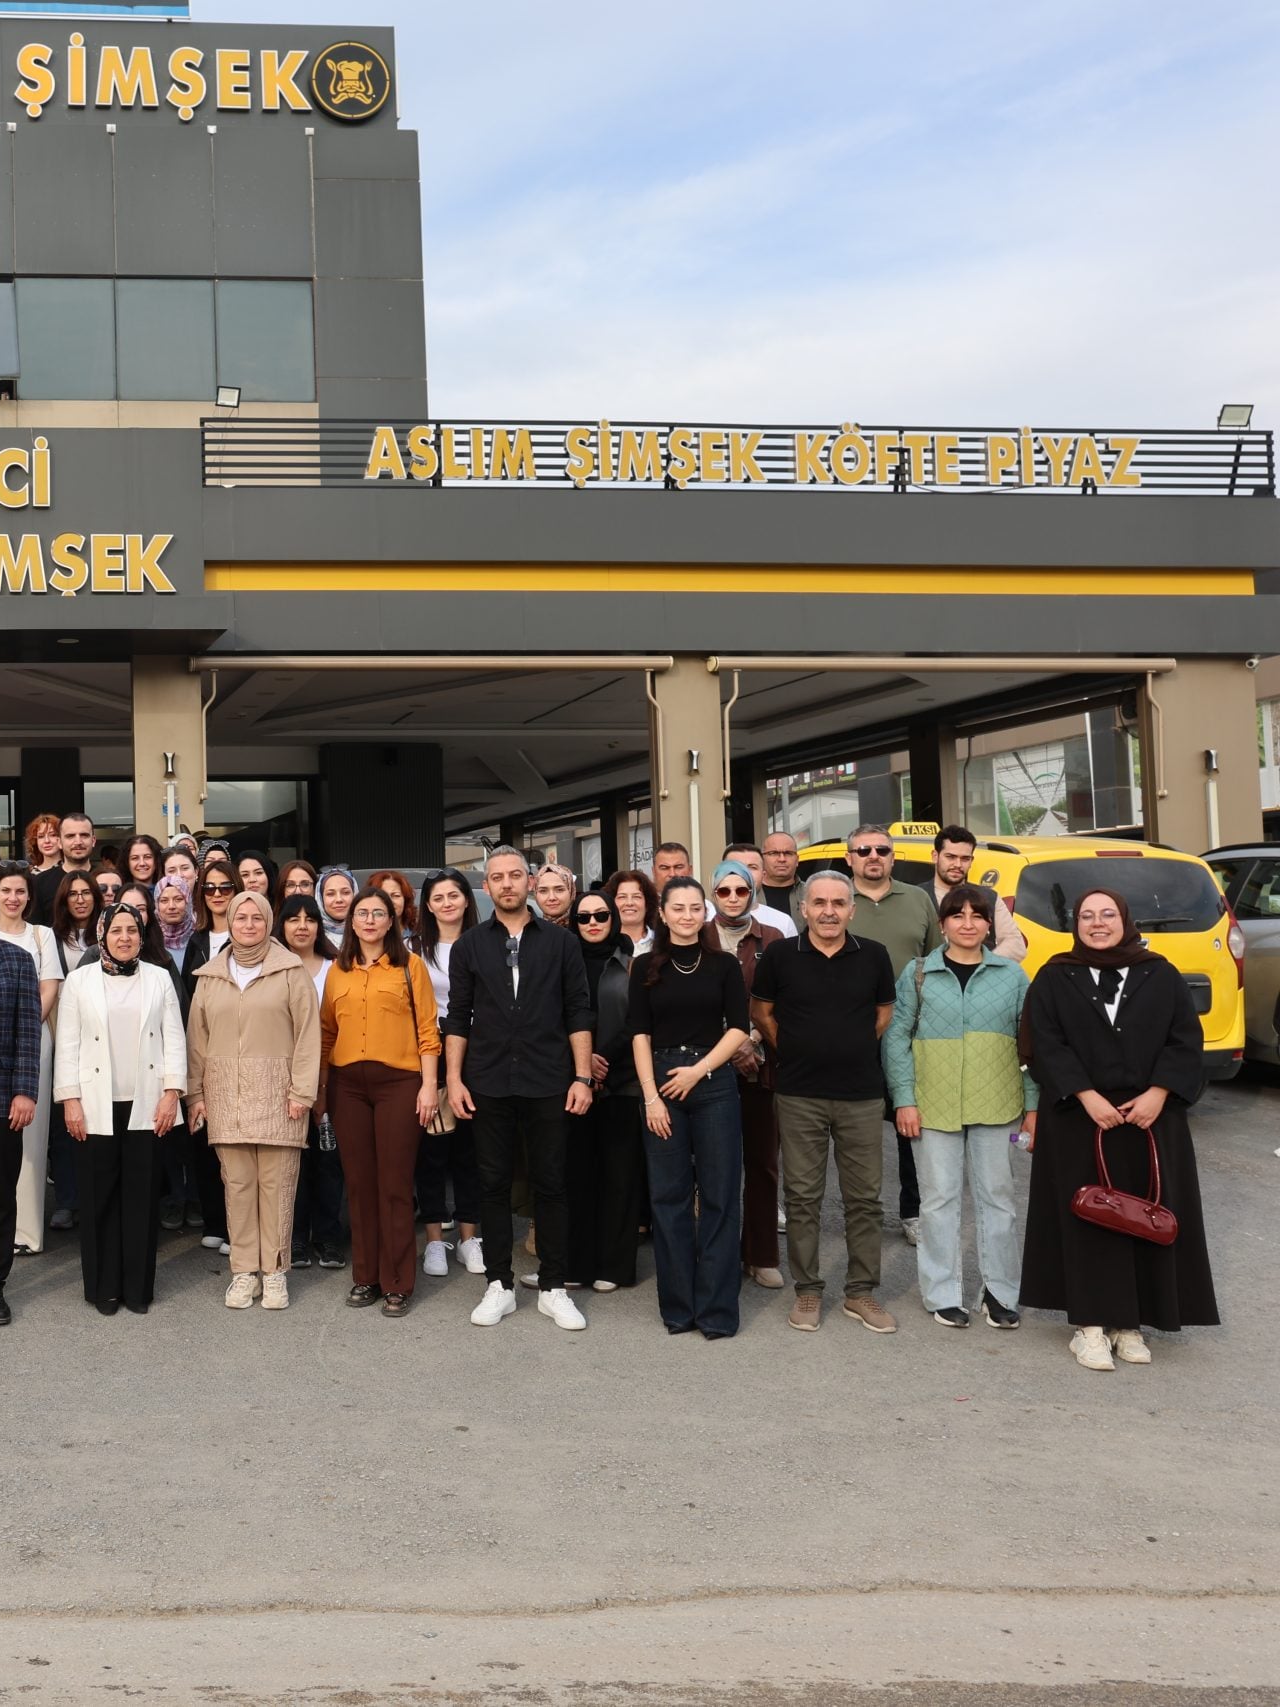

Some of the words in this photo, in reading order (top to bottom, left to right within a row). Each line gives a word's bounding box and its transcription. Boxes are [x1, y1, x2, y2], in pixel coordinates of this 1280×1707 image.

[14, 32, 312, 121] ŞİMŞEK
[363, 425, 538, 481] ASLIM
[565, 418, 768, 489] ŞİMŞEK
[794, 421, 962, 487] KÖFTE
[986, 425, 1142, 488] PİYAZ
[985, 871, 996, 882] 7
